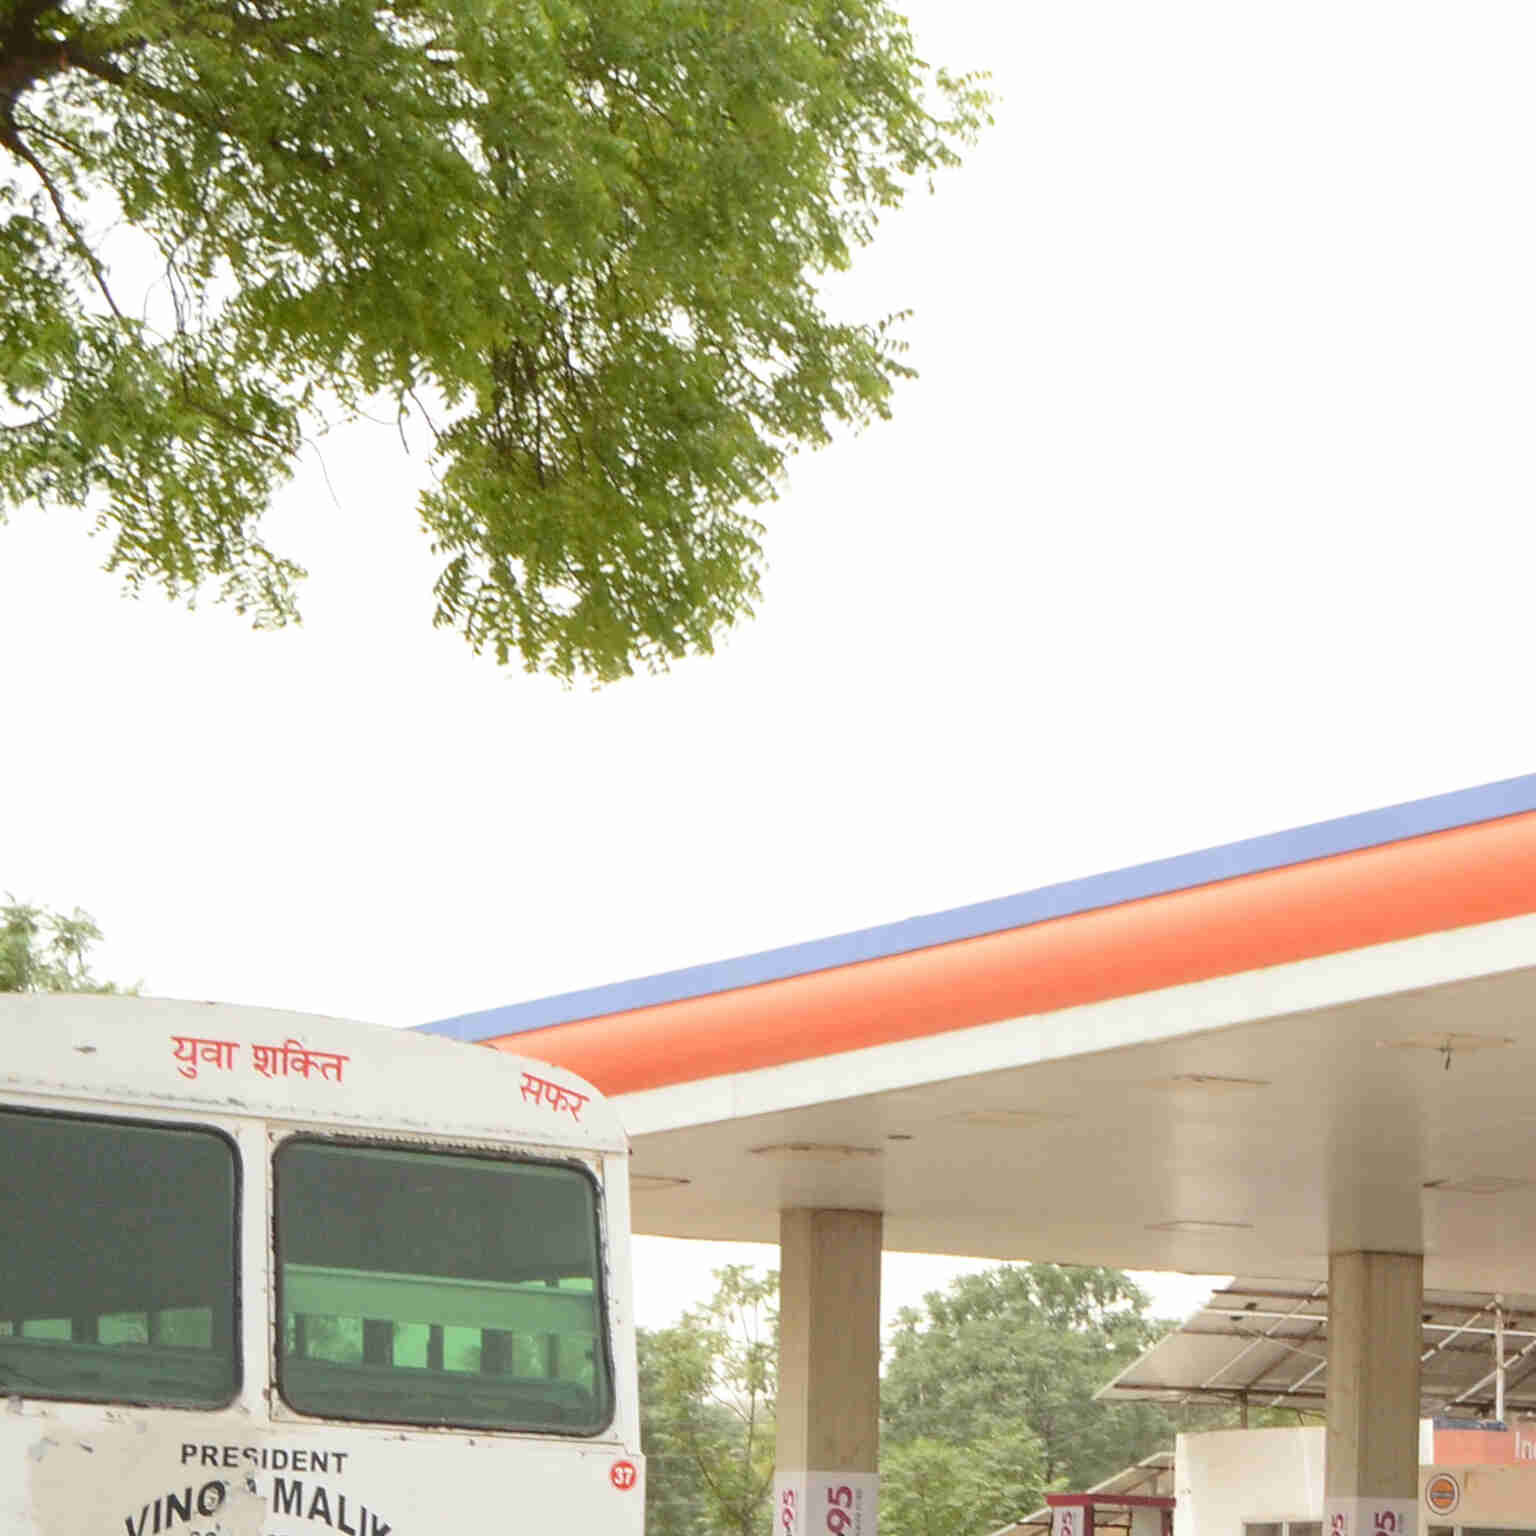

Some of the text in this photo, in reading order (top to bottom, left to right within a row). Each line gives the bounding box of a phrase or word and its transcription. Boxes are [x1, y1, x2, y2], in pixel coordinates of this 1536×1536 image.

[171, 1035, 240, 1079] युवा
[519, 1072, 590, 1121] सफर
[181, 1443, 348, 1473] PRESIDENT
